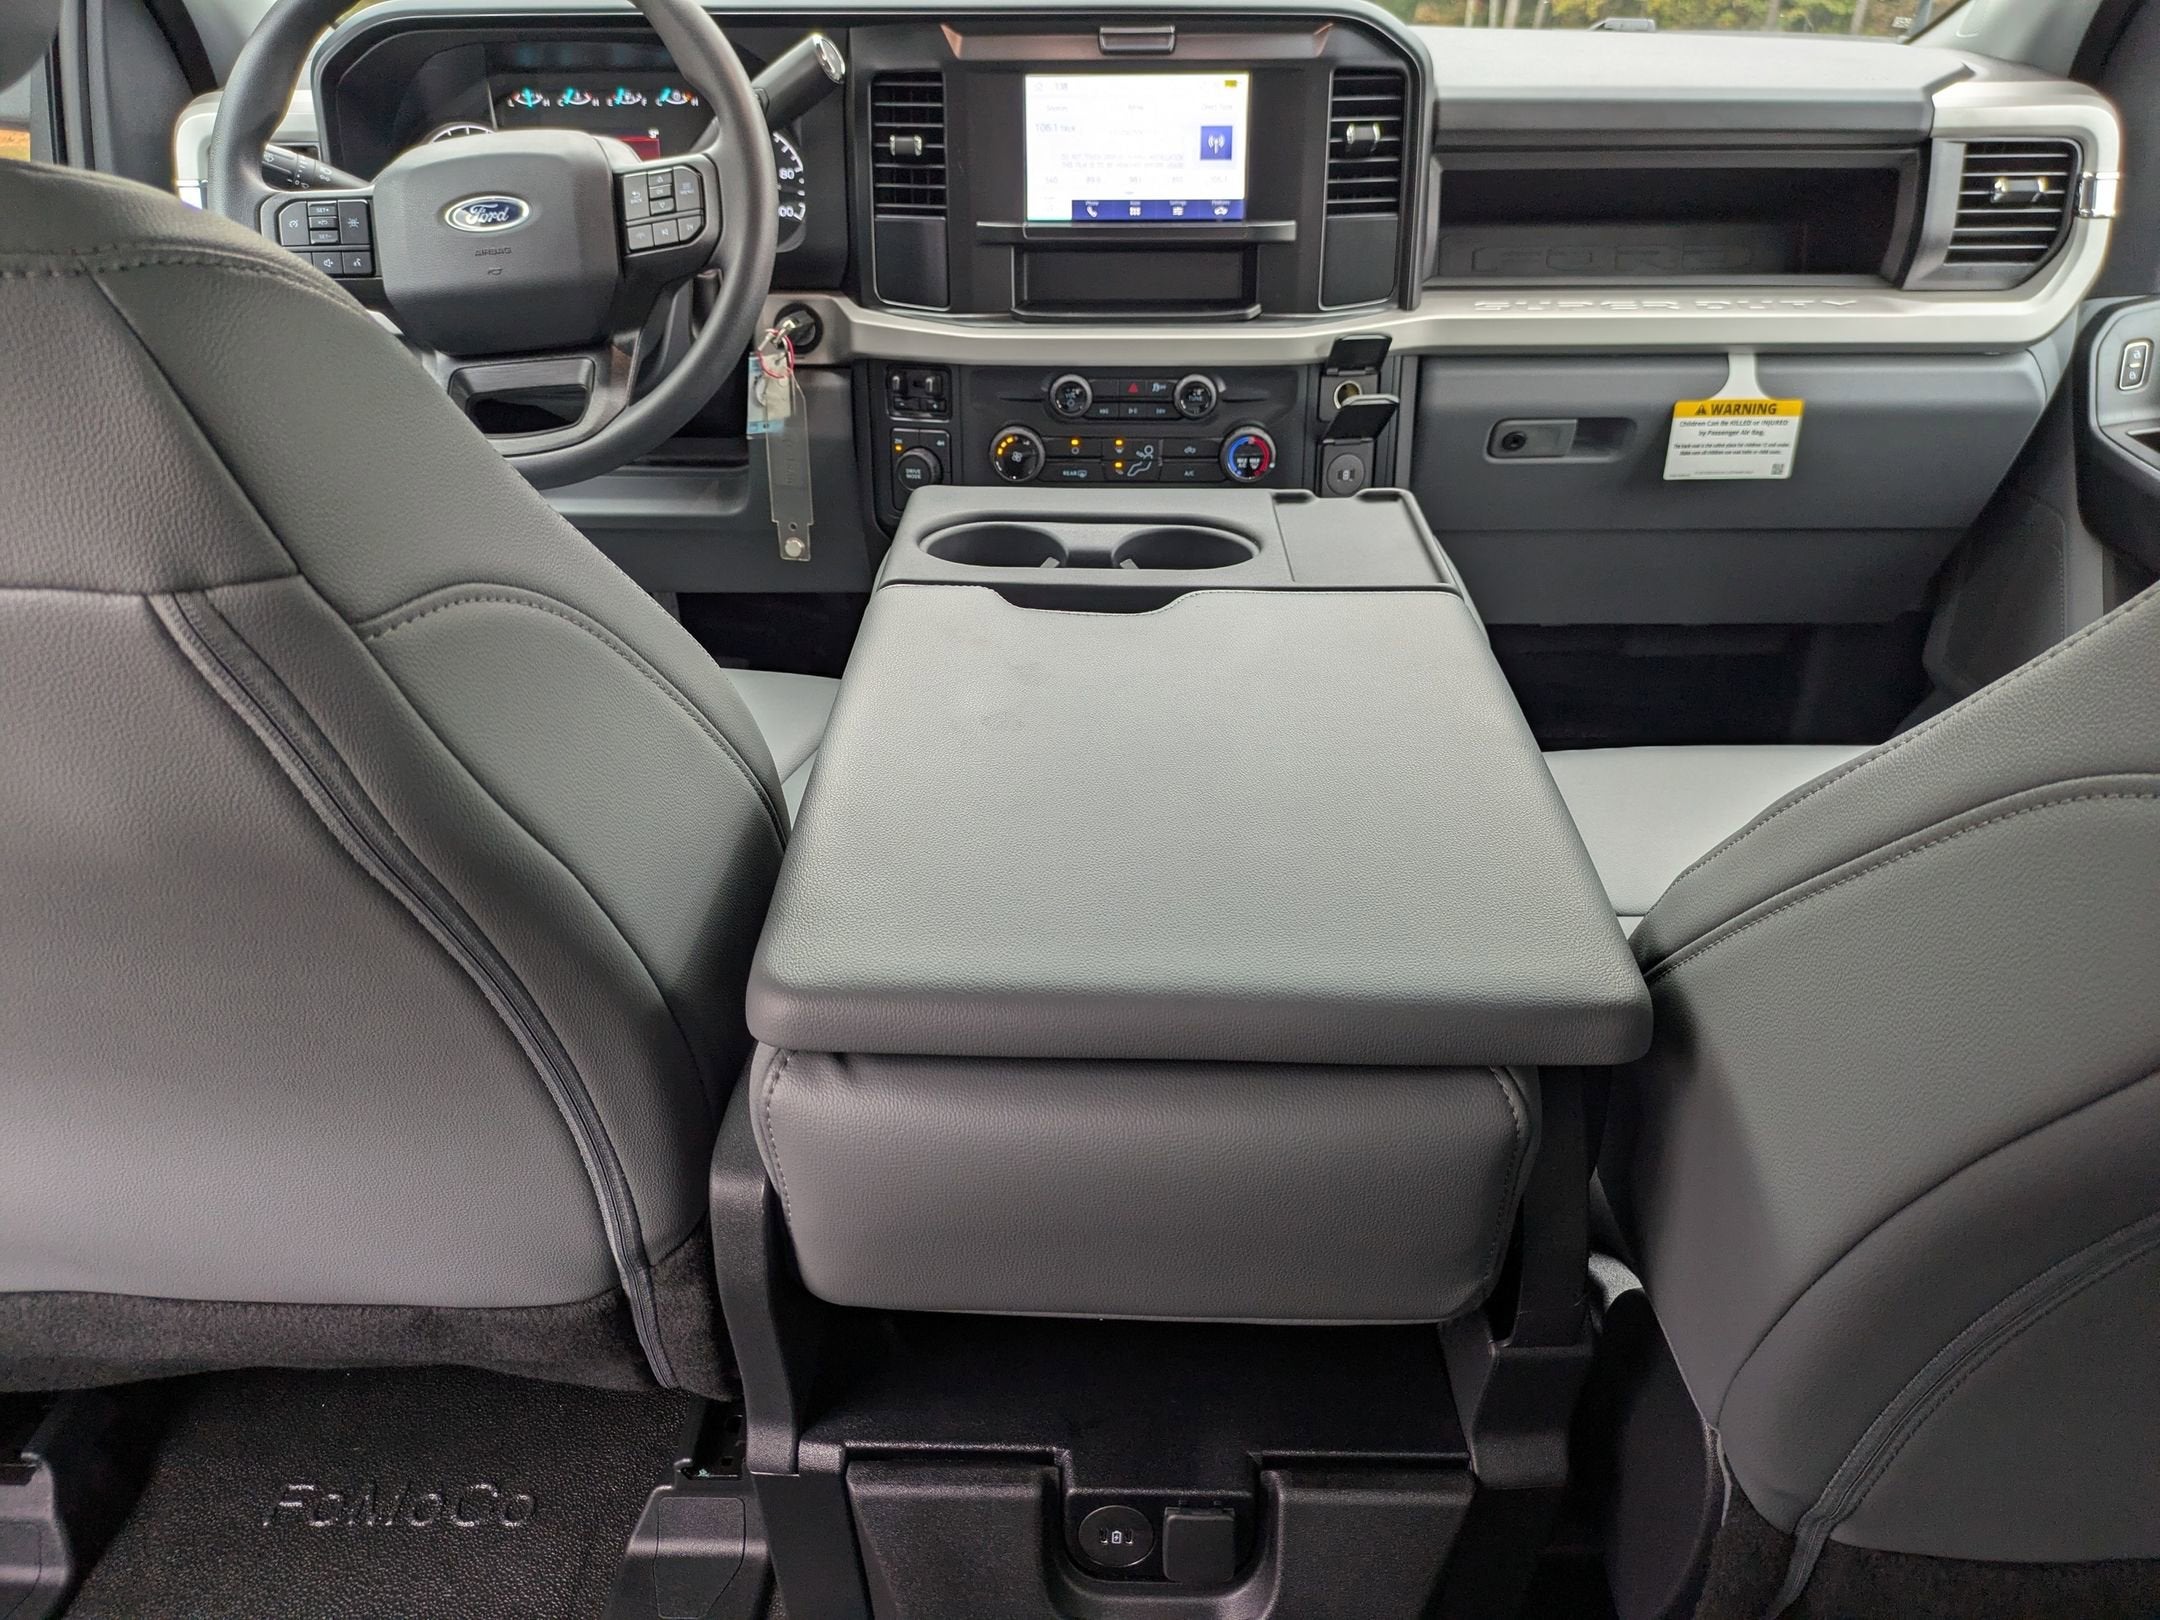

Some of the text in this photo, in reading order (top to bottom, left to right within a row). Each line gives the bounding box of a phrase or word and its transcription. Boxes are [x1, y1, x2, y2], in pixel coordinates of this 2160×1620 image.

[779, 167, 795, 180] 80
[467, 203, 509, 224] Ford
[778, 205, 794, 218] 00
[1471, 245, 1752, 272] FORD
[1474, 300, 1857, 311] SUPER DUTY
[1710, 403, 1778, 416] WARNING
[1680, 420, 1706, 428] Children
[1761, 419, 1789, 427] INJURED
[1707, 429, 1740, 437] Passenger
[261, 1482, 538, 1528] FoMoCo
